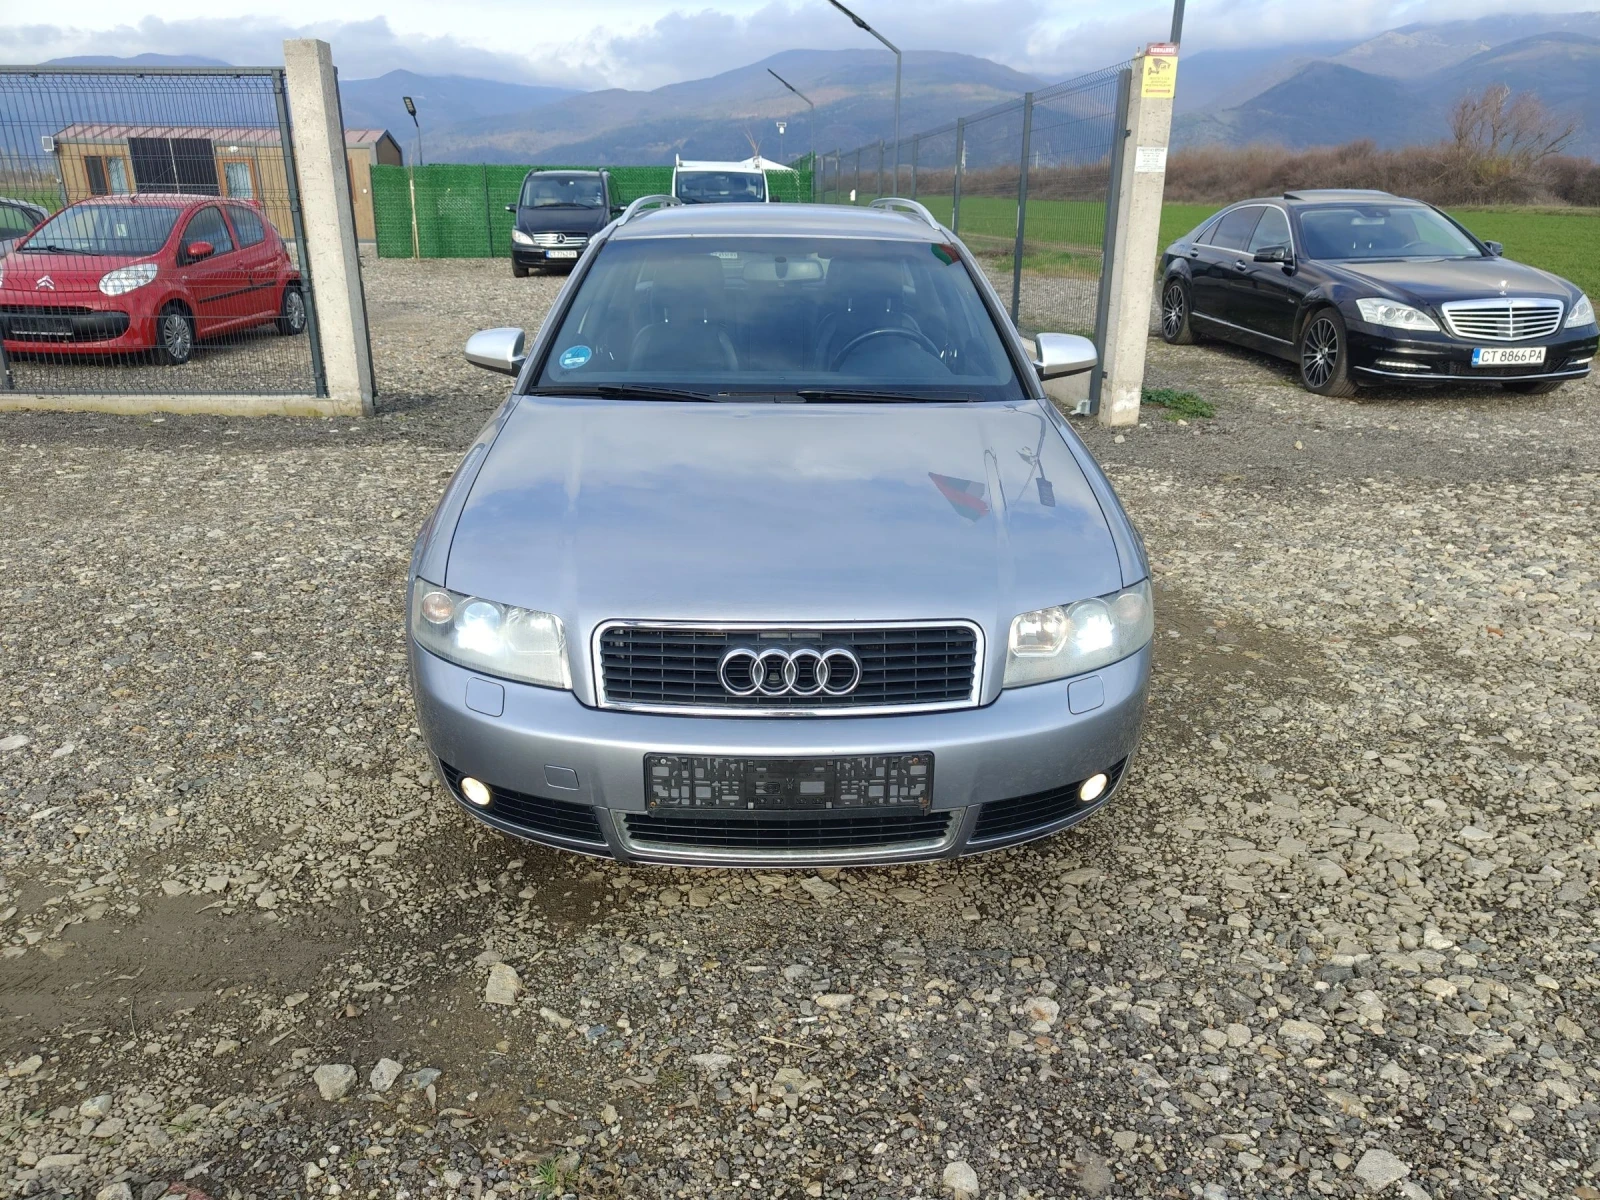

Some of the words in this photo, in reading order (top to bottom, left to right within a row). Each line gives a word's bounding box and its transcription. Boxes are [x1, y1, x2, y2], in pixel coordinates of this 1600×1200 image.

[1481, 351, 1498, 362] CT
[1500, 350, 1527, 362] 8866
[1529, 349, 1542, 361] PA
